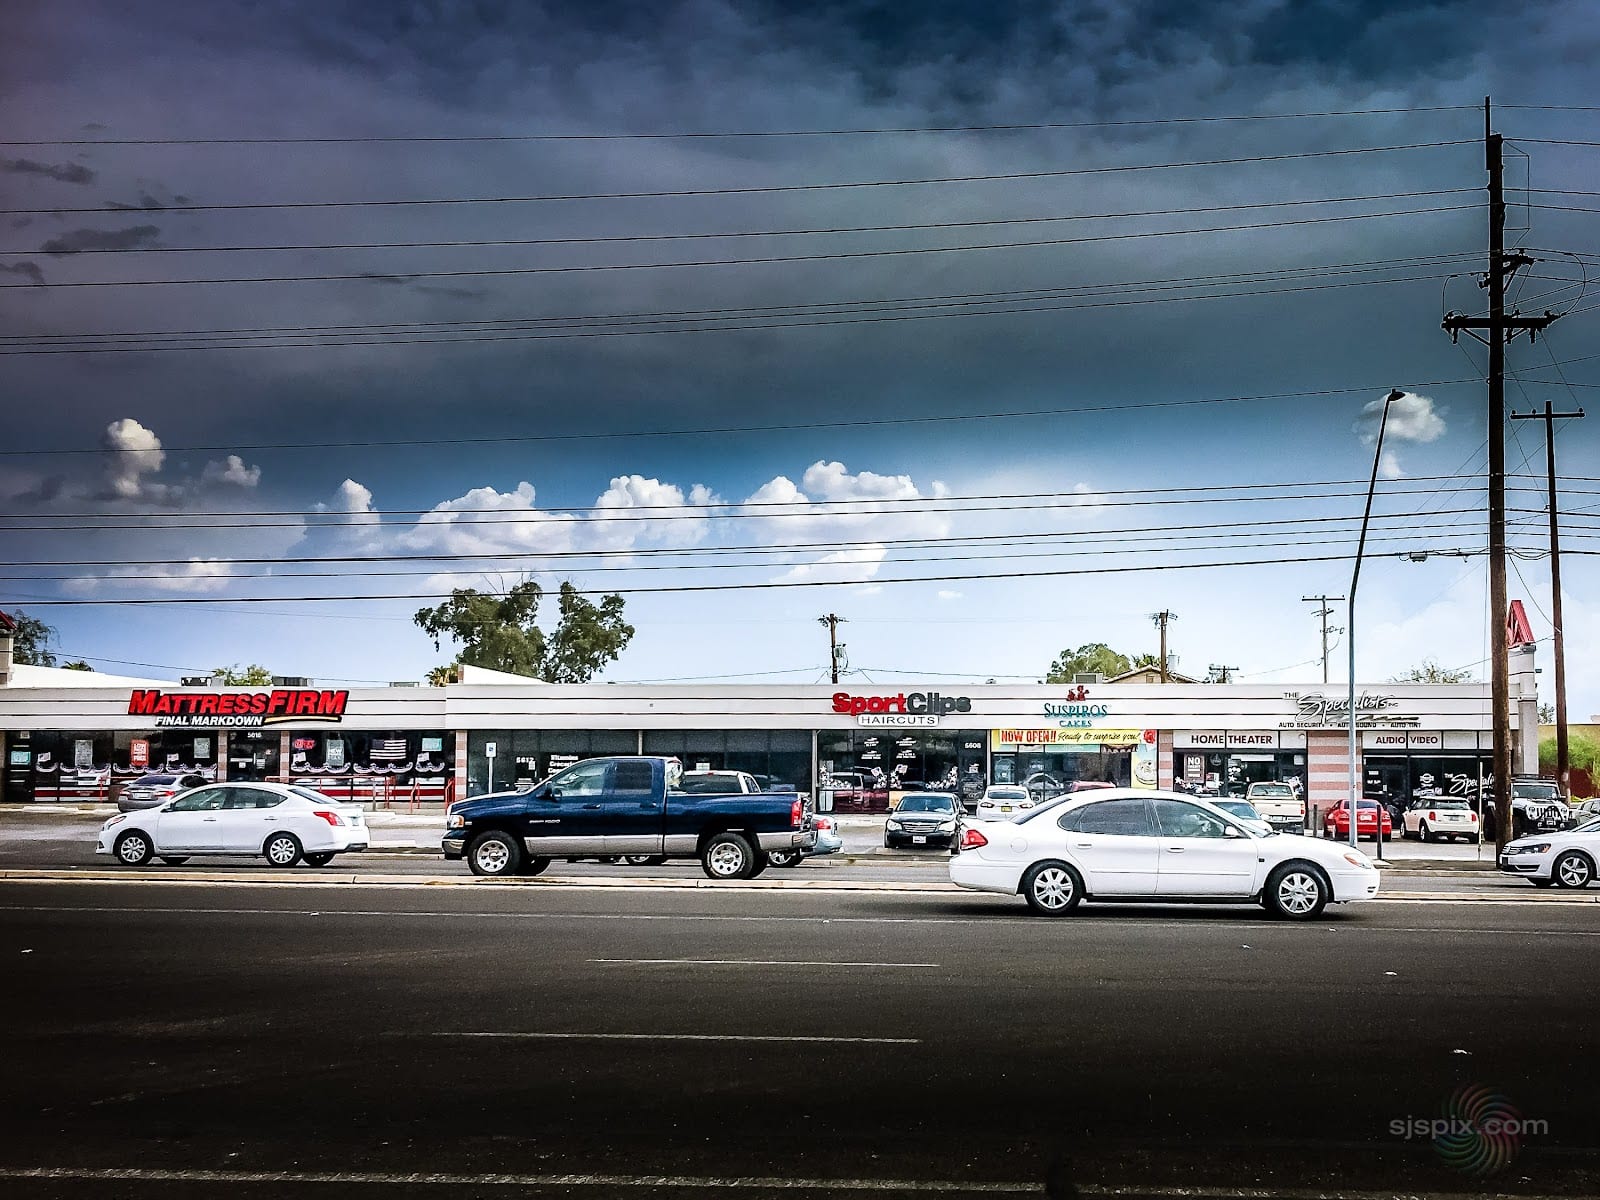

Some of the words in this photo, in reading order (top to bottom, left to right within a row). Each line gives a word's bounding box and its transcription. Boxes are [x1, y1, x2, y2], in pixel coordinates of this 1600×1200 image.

[1044, 703, 1109, 718] SUSPIROS
[1295, 691, 1391, 724] Specalists
[155, 717, 189, 726] FINAL
[190, 717, 263, 726] MARKDOWN
[861, 716, 936, 725] HAIRCUTS
[1059, 720, 1092, 728] CAKES
[1001, 731, 1023, 742] NOW
[1026, 731, 1057, 743] OPEN!!
[1057, 732, 1081, 742] Ready
[1083, 732, 1092, 740] to
[1093, 732, 1121, 742] surprise
[1122, 732, 1140, 742] you!
[1191, 735, 1224, 744] HOME
[1227, 735, 1273, 744] THEATER
[1375, 736, 1406, 744] AUDIO
[1409, 736, 1438, 744] VIDEO
[1187, 756, 1201, 765] NO
